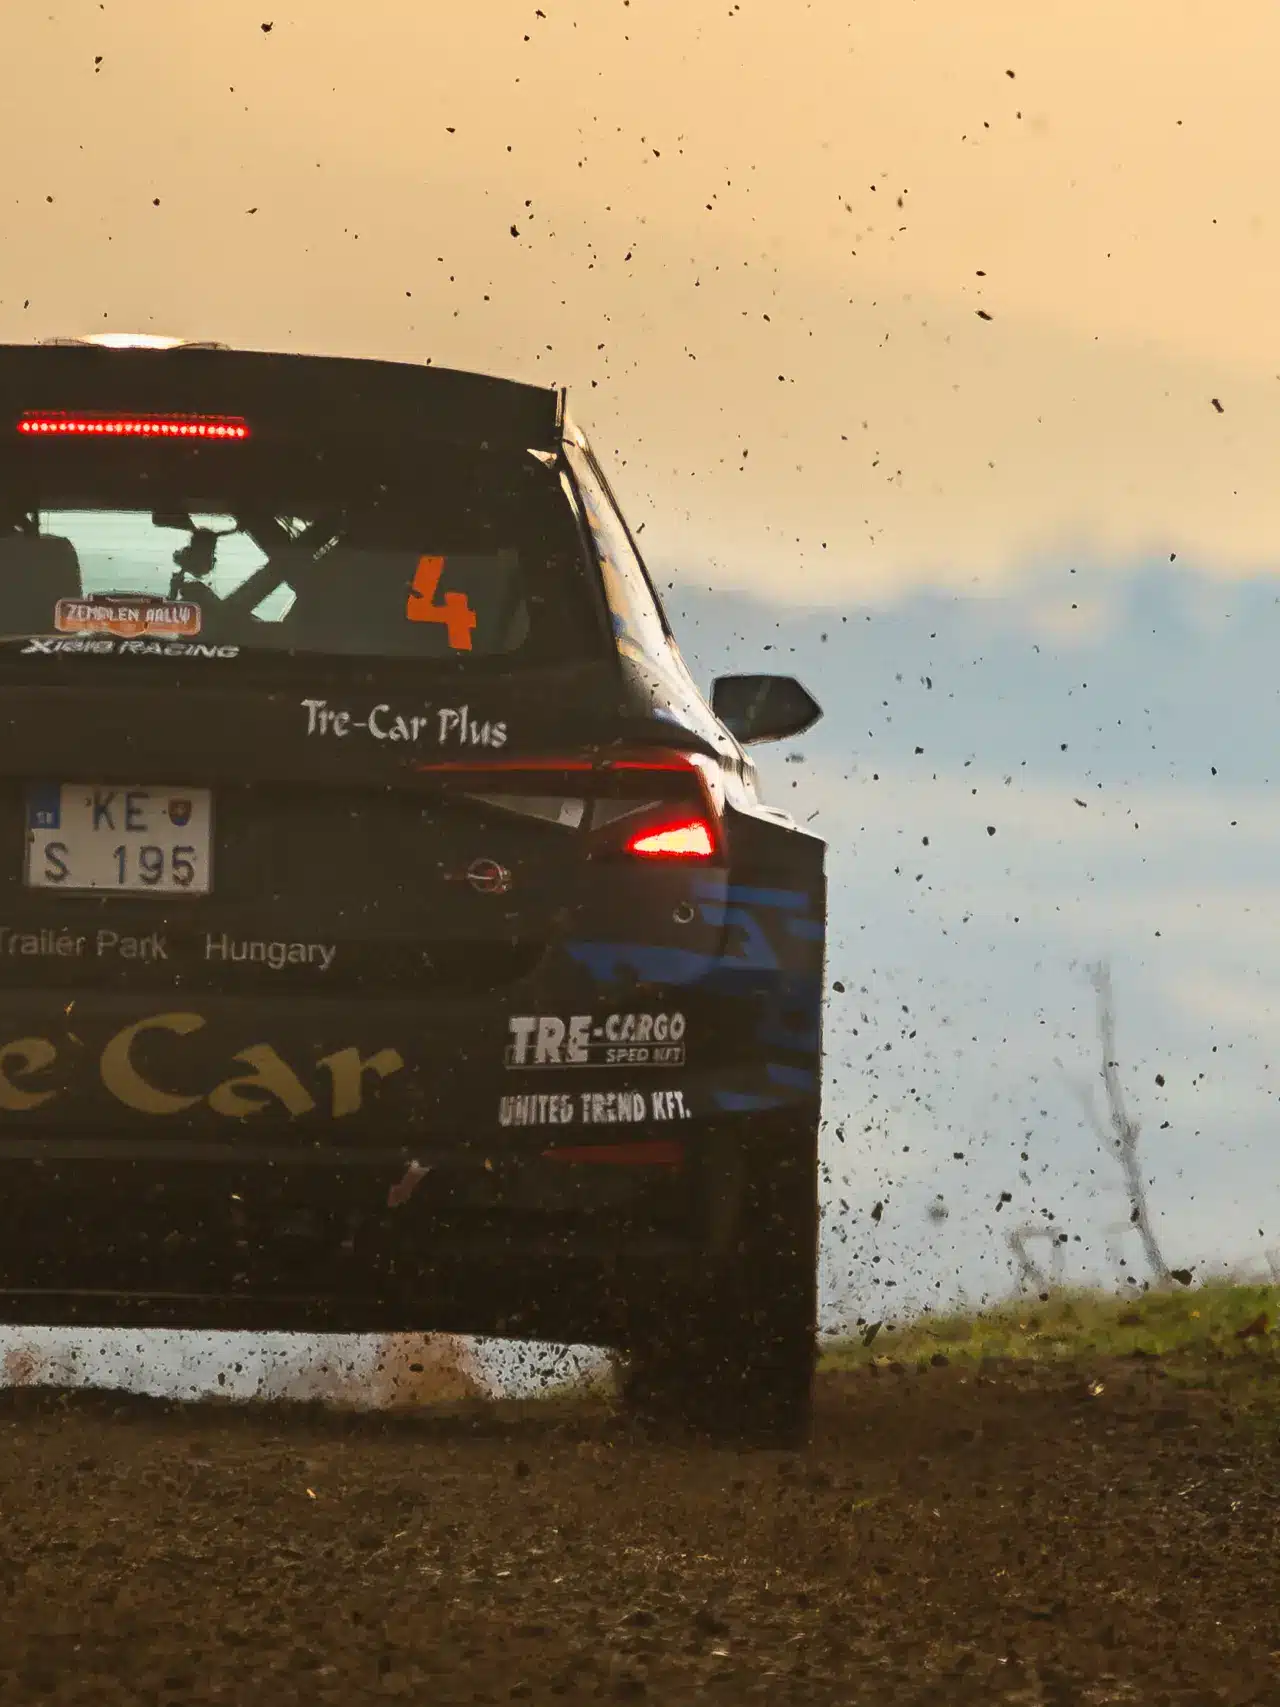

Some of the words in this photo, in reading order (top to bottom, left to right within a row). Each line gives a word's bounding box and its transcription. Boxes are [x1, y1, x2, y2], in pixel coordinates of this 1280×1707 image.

[407, 554, 477, 651] 4
[120, 640, 240, 659] RACING
[300, 698, 428, 742] Tre-Car
[436, 704, 508, 749] Plus
[91, 786, 150, 832] KE
[43, 841, 70, 884] S
[112, 844, 195, 887] 195
[96, 928, 169, 961] Park
[205, 933, 337, 971] Hungary
[99, 1011, 405, 1118] Car
[498, 1093, 575, 1127] UNITED
[579, 1089, 647, 1124] TREND
